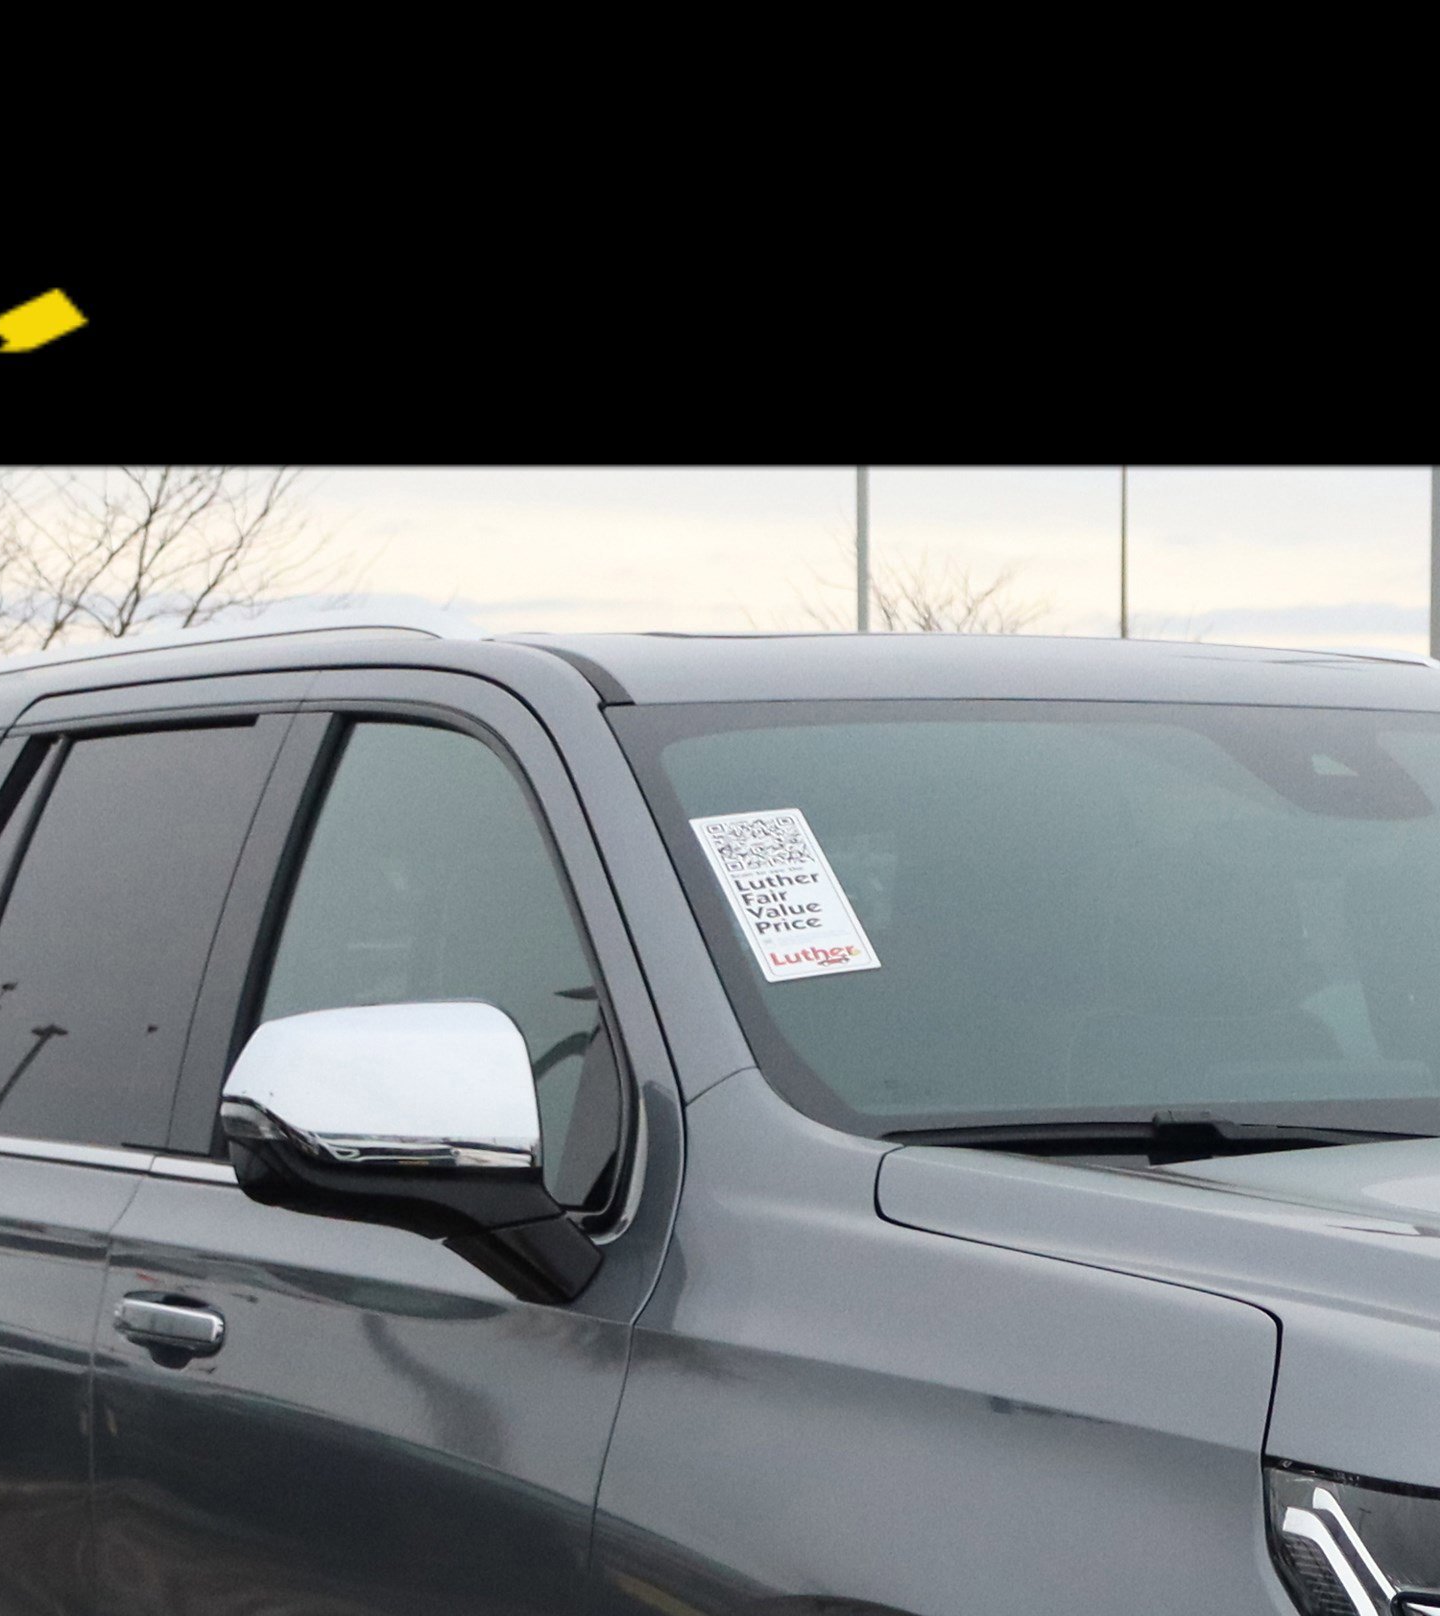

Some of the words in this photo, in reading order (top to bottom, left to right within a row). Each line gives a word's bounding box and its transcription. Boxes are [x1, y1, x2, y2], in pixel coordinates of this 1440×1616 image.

[734, 872, 820, 892] Luther
[741, 889, 788, 906] Fair
[746, 902, 823, 919] Value
[755, 917, 823, 935] Price
[769, 944, 856, 966] Luther
